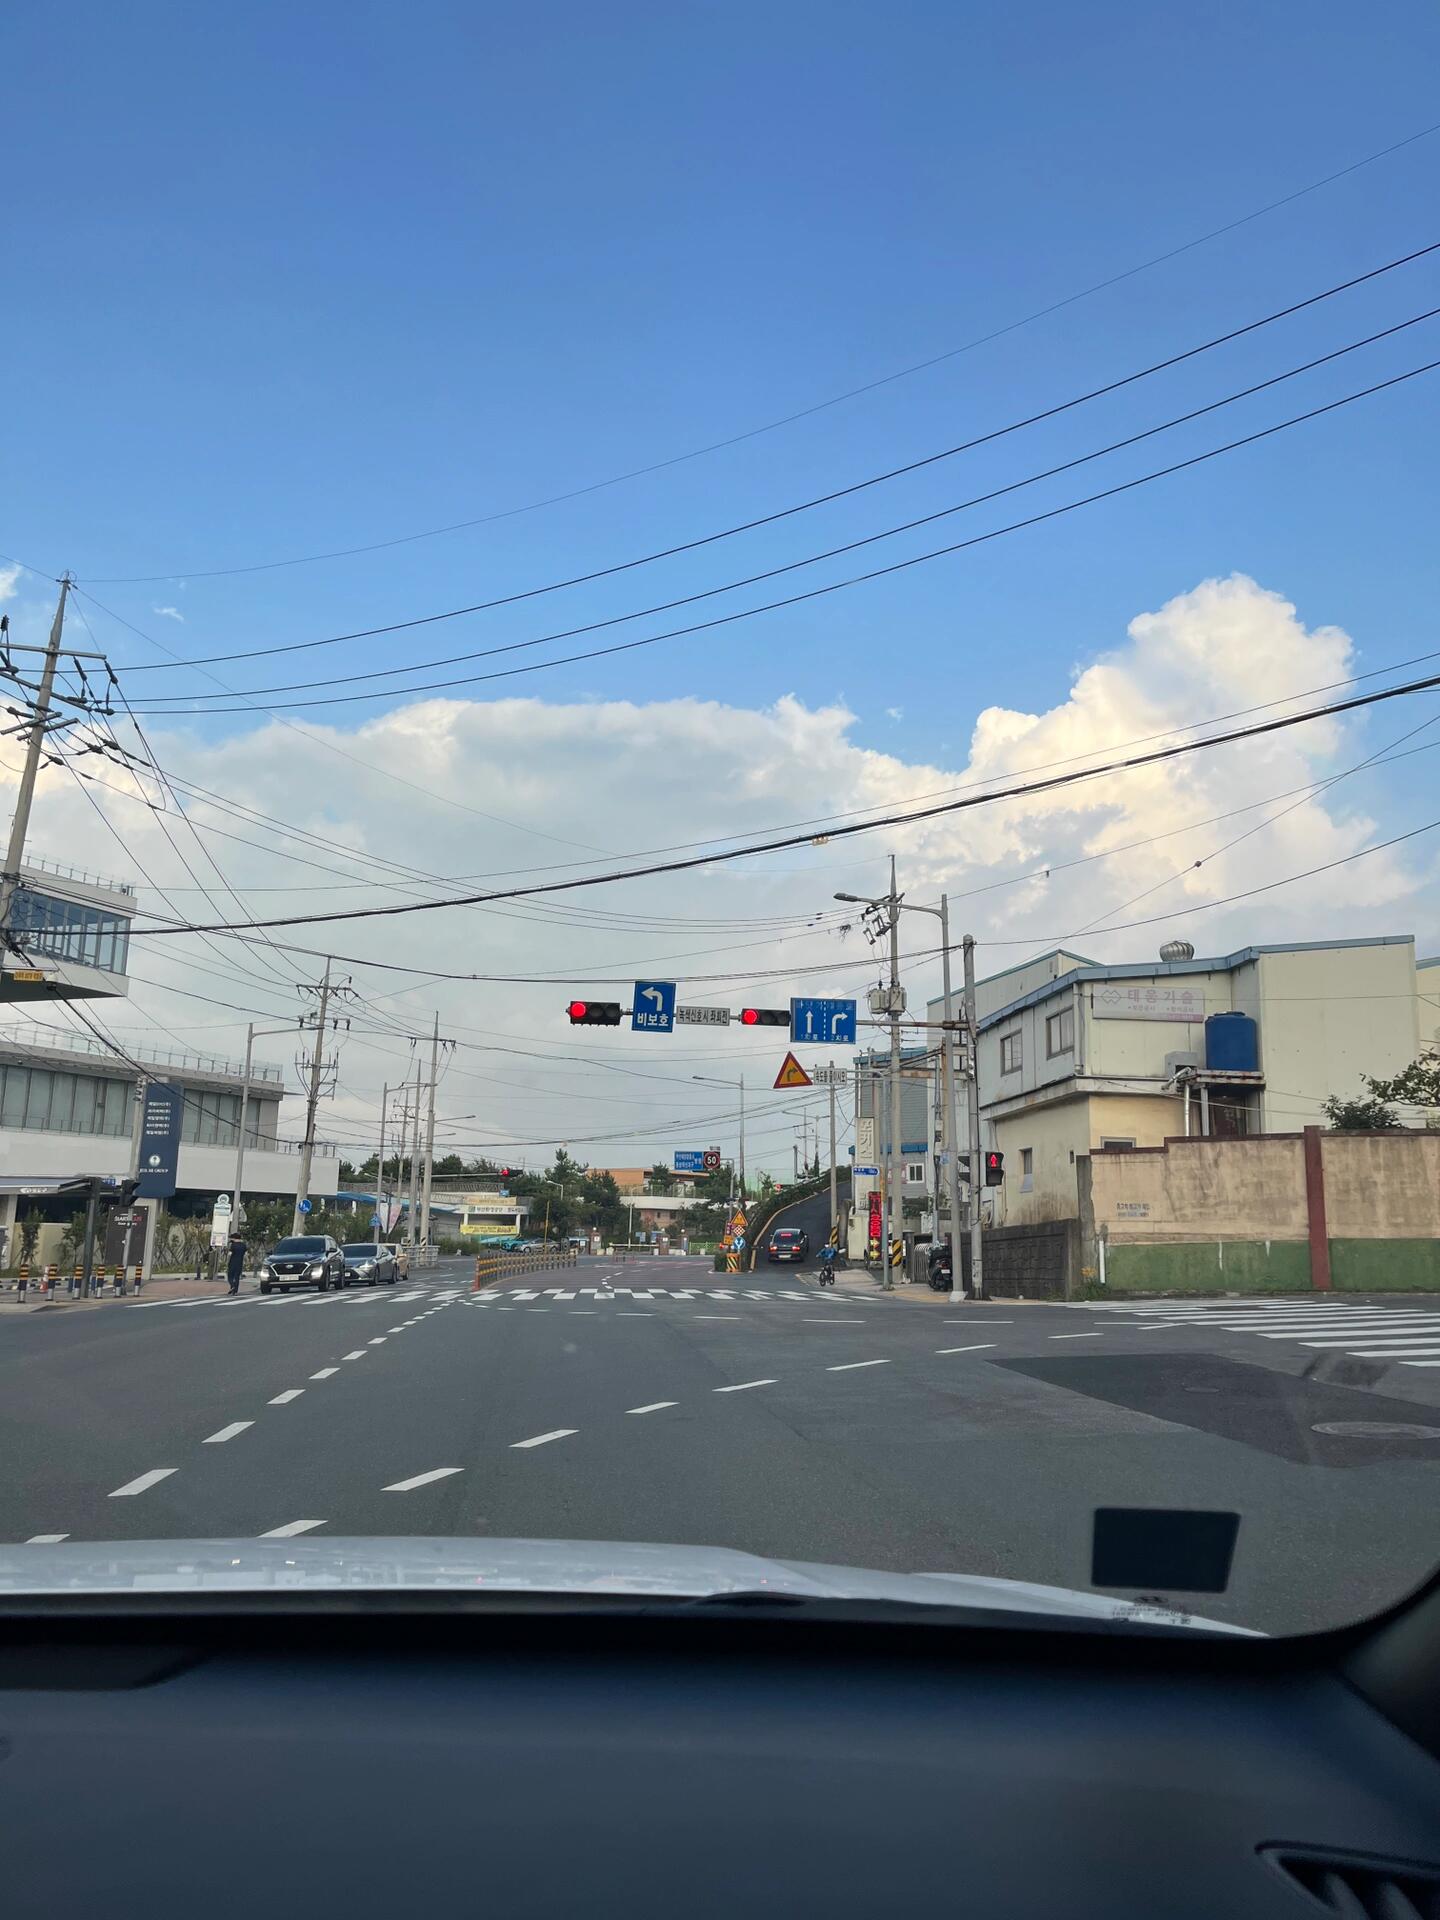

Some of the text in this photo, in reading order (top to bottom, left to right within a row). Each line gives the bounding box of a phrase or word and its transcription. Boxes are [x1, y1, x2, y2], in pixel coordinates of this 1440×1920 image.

[1128, 989, 1194, 1005] 태웅기술
[637, 1013, 668, 1026] 비보호
[707, 1156, 717, 1164] 50
